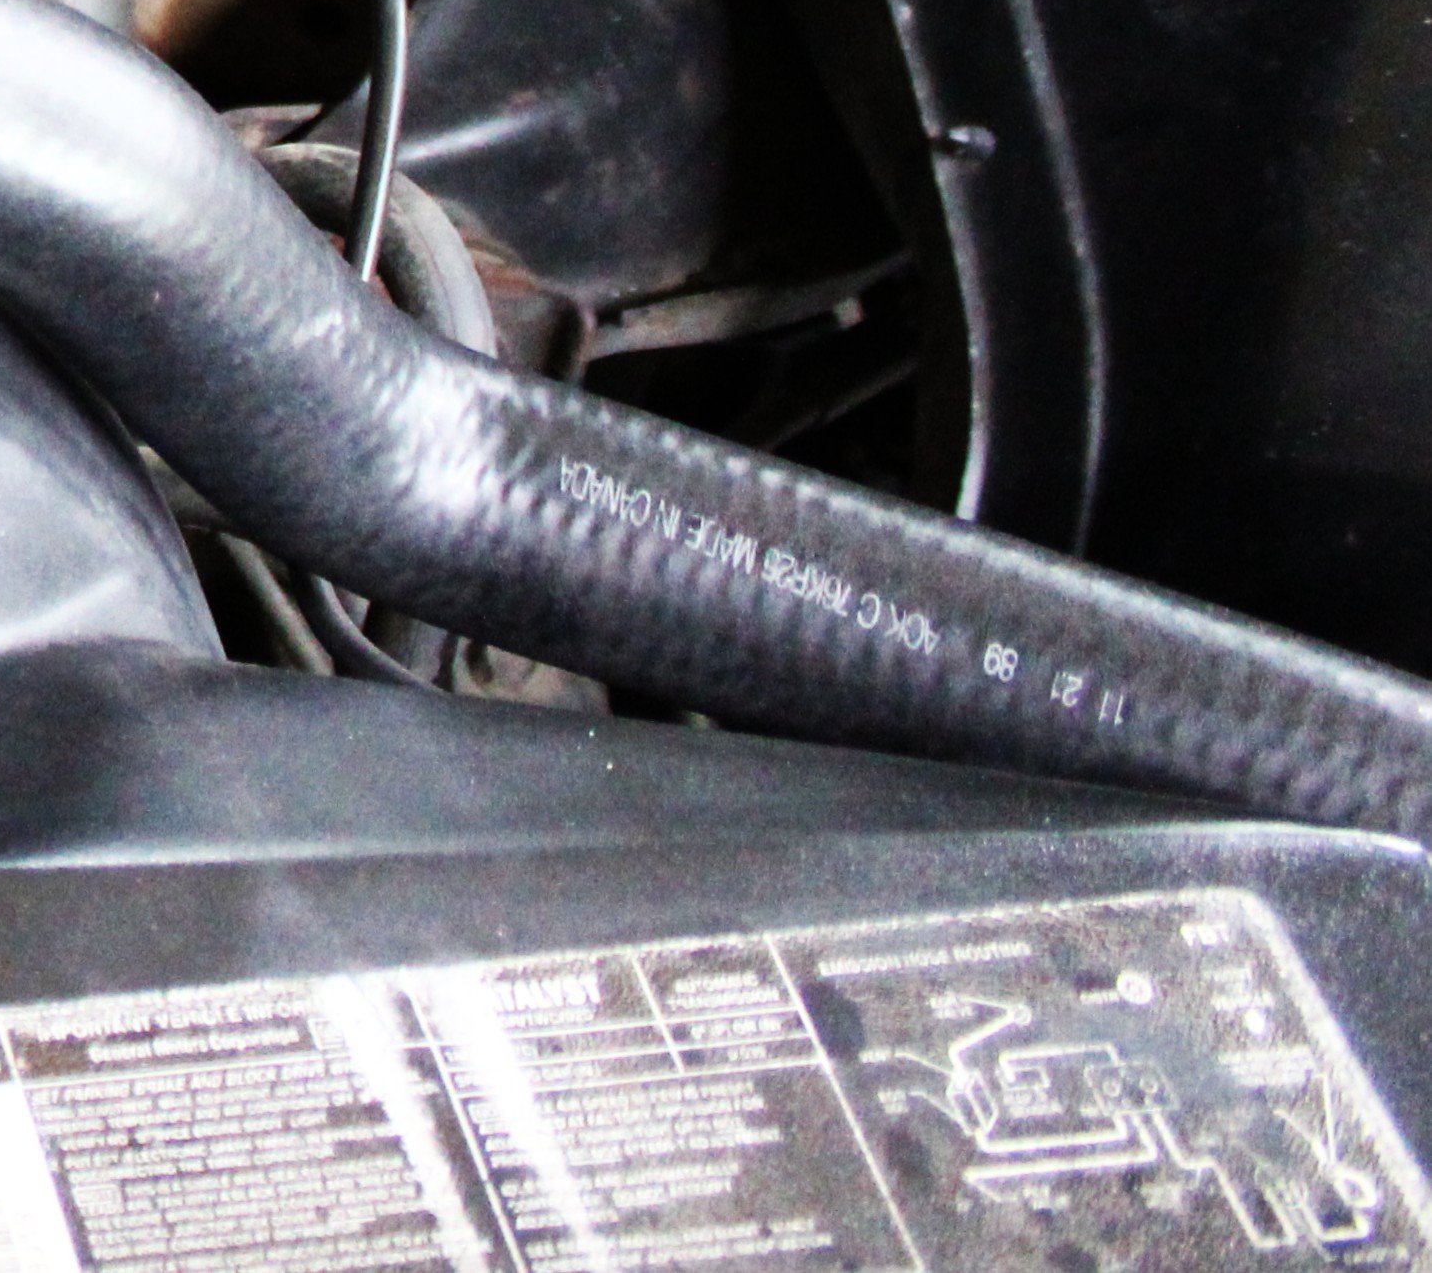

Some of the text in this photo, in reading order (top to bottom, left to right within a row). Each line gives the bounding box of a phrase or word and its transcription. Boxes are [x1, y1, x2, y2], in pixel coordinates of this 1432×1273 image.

[559, 456, 652, 528] CANADA
[655, 498, 683, 541] IN
[683, 513, 759, 575] MADE
[983, 642, 1020, 683] 89
